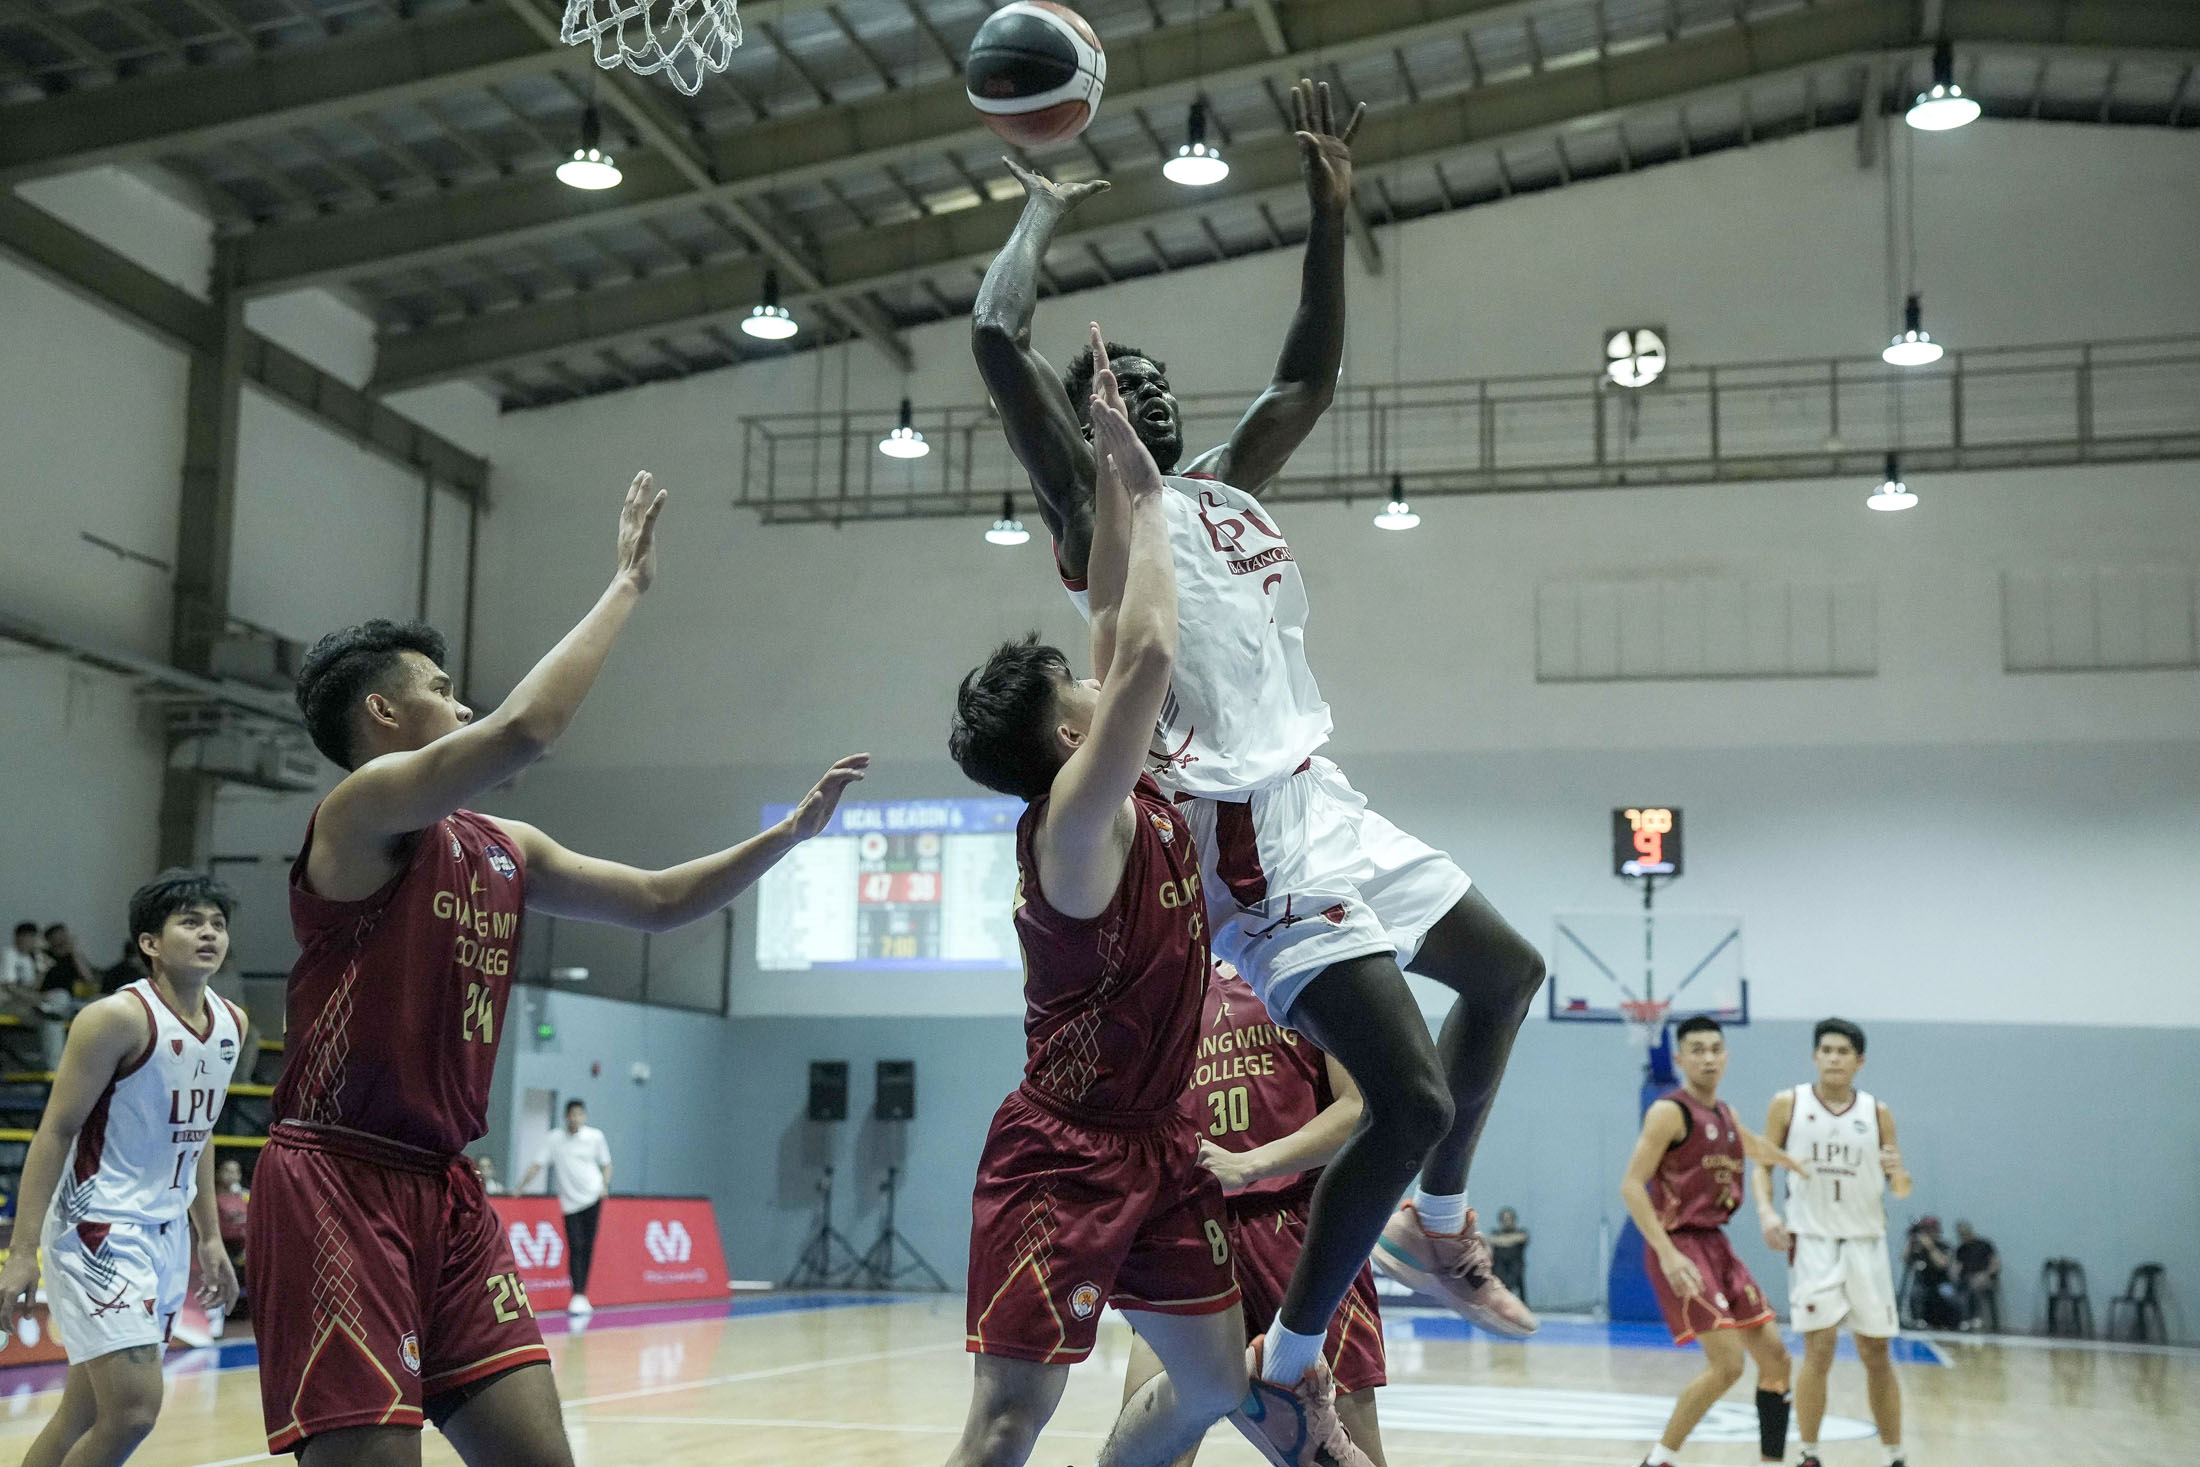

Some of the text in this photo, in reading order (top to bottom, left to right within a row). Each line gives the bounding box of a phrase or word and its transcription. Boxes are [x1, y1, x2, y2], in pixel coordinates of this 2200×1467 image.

[462, 982, 493, 1044] 24
[1207, 1086, 1251, 1138] 30
[1203, 1218, 1229, 1266] 8
[486, 1273, 534, 1324] 24
